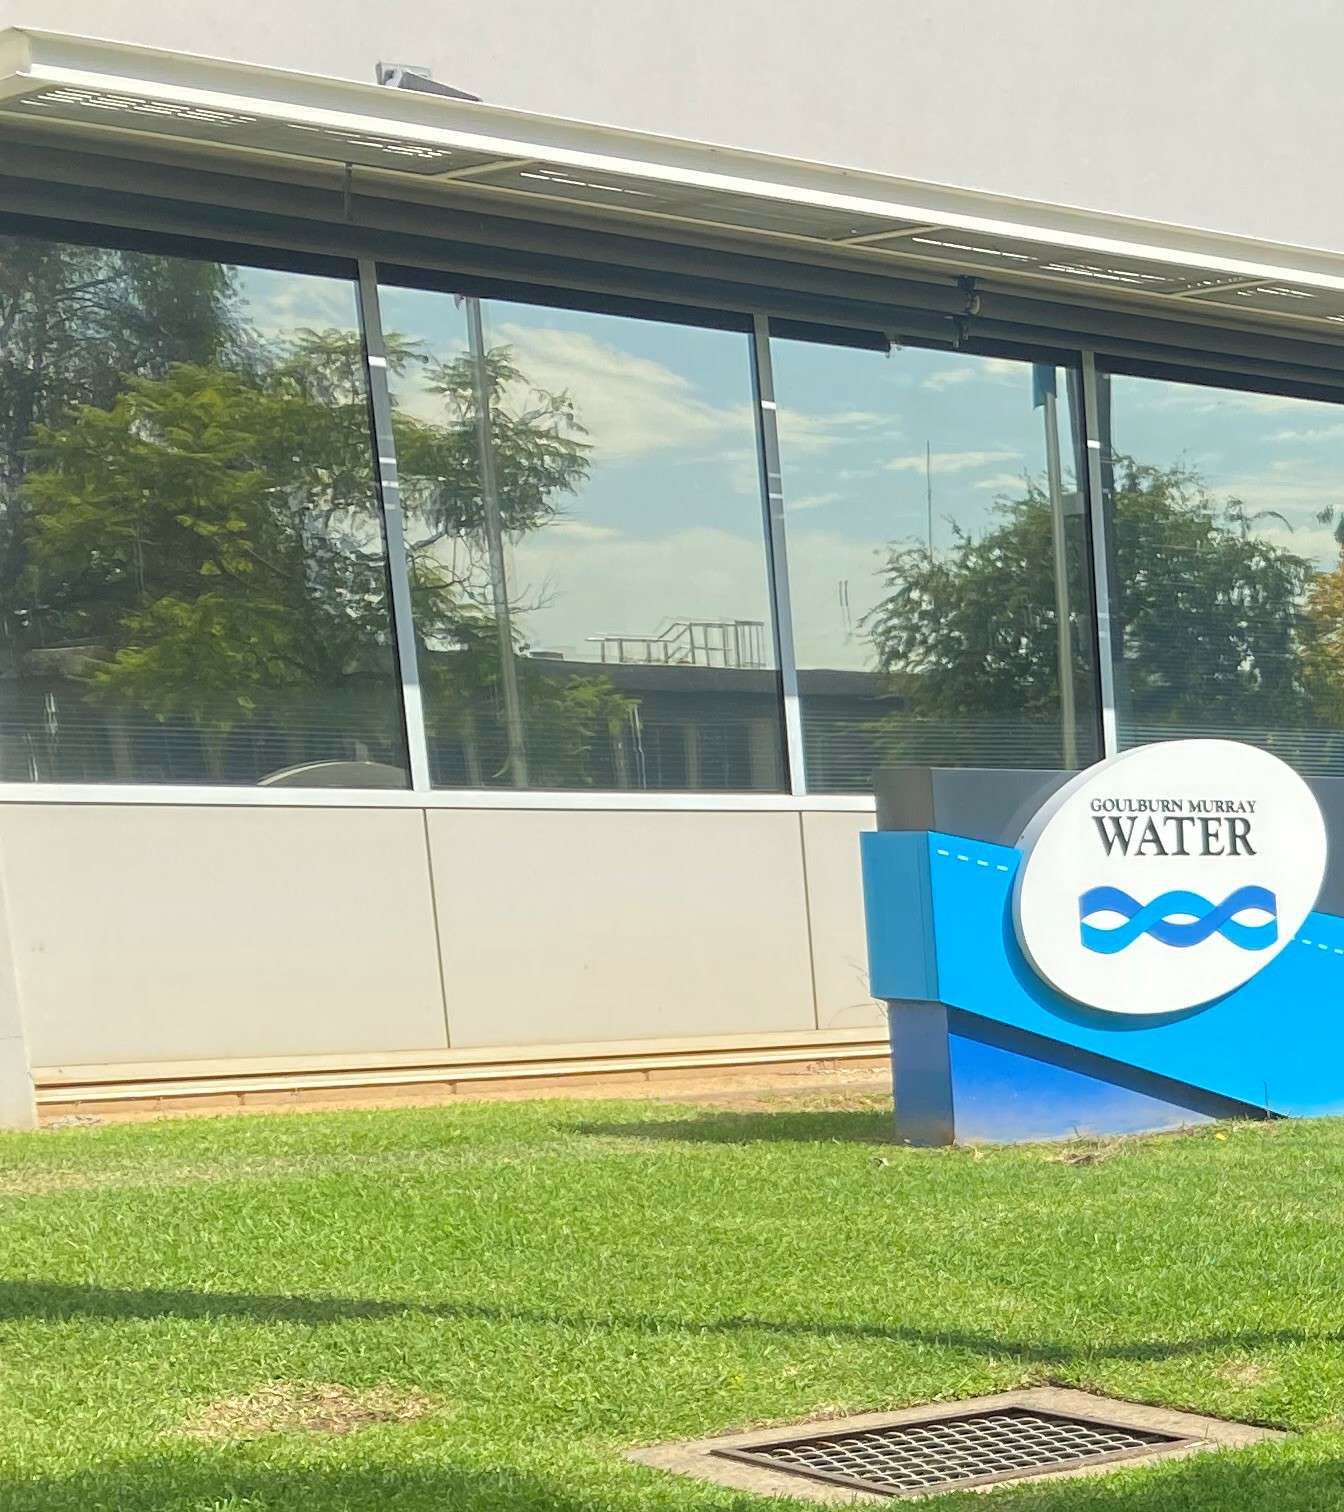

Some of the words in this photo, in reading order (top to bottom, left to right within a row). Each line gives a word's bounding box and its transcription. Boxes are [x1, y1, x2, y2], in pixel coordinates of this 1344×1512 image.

[1090, 798, 1183, 813] GOULBURN
[1188, 799, 1257, 814] MURRAY
[1091, 815, 1258, 857] WATER
